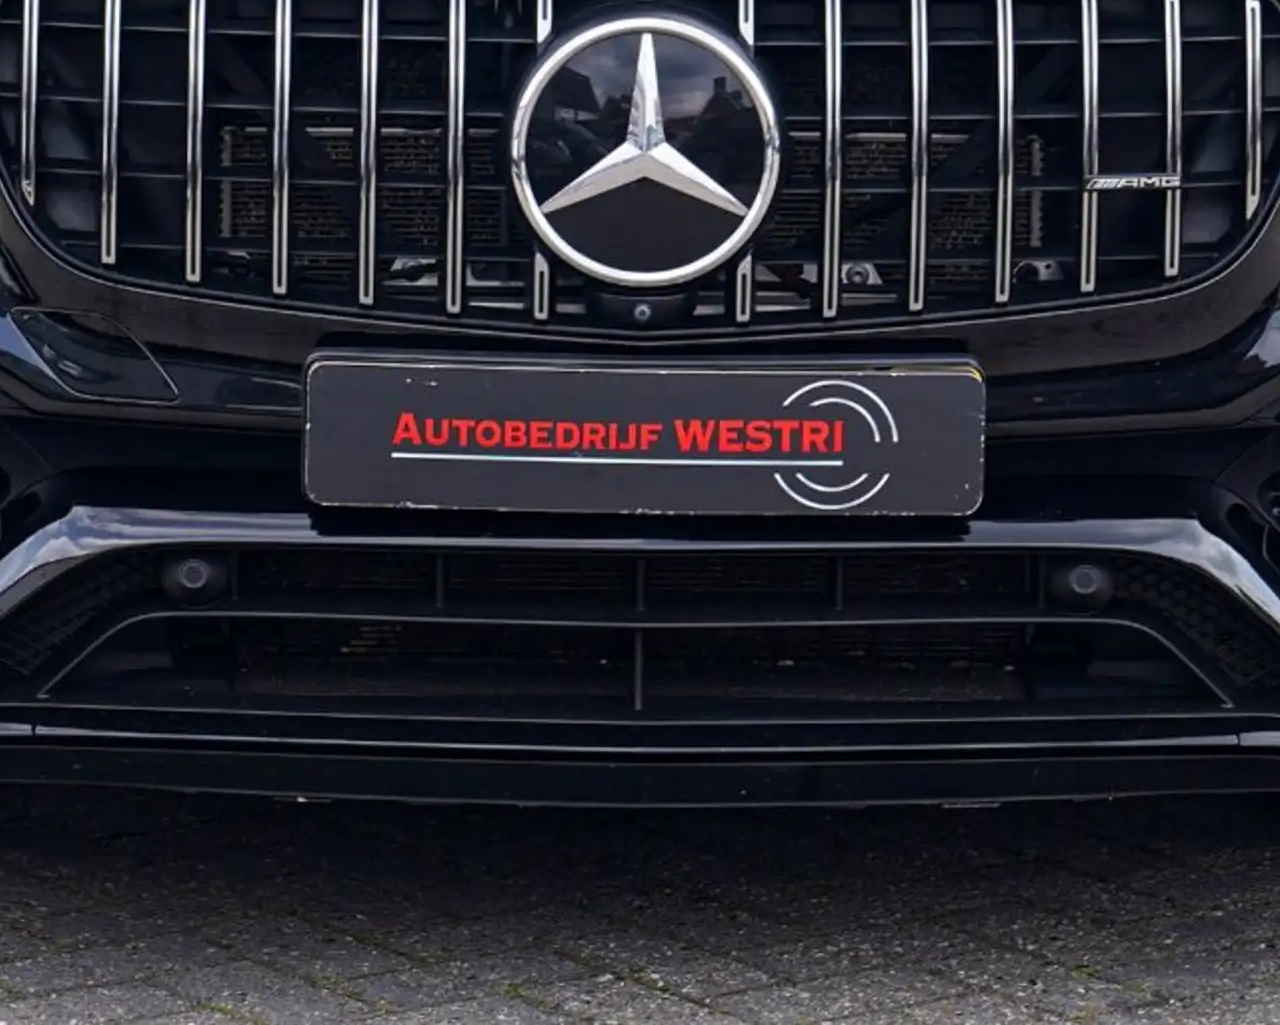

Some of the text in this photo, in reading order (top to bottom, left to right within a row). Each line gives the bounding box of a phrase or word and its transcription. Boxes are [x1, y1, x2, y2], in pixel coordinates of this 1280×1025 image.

[1119, 176, 1180, 189] AMG
[392, 412, 844, 452] AUTOBEDRIJF WESTRI
